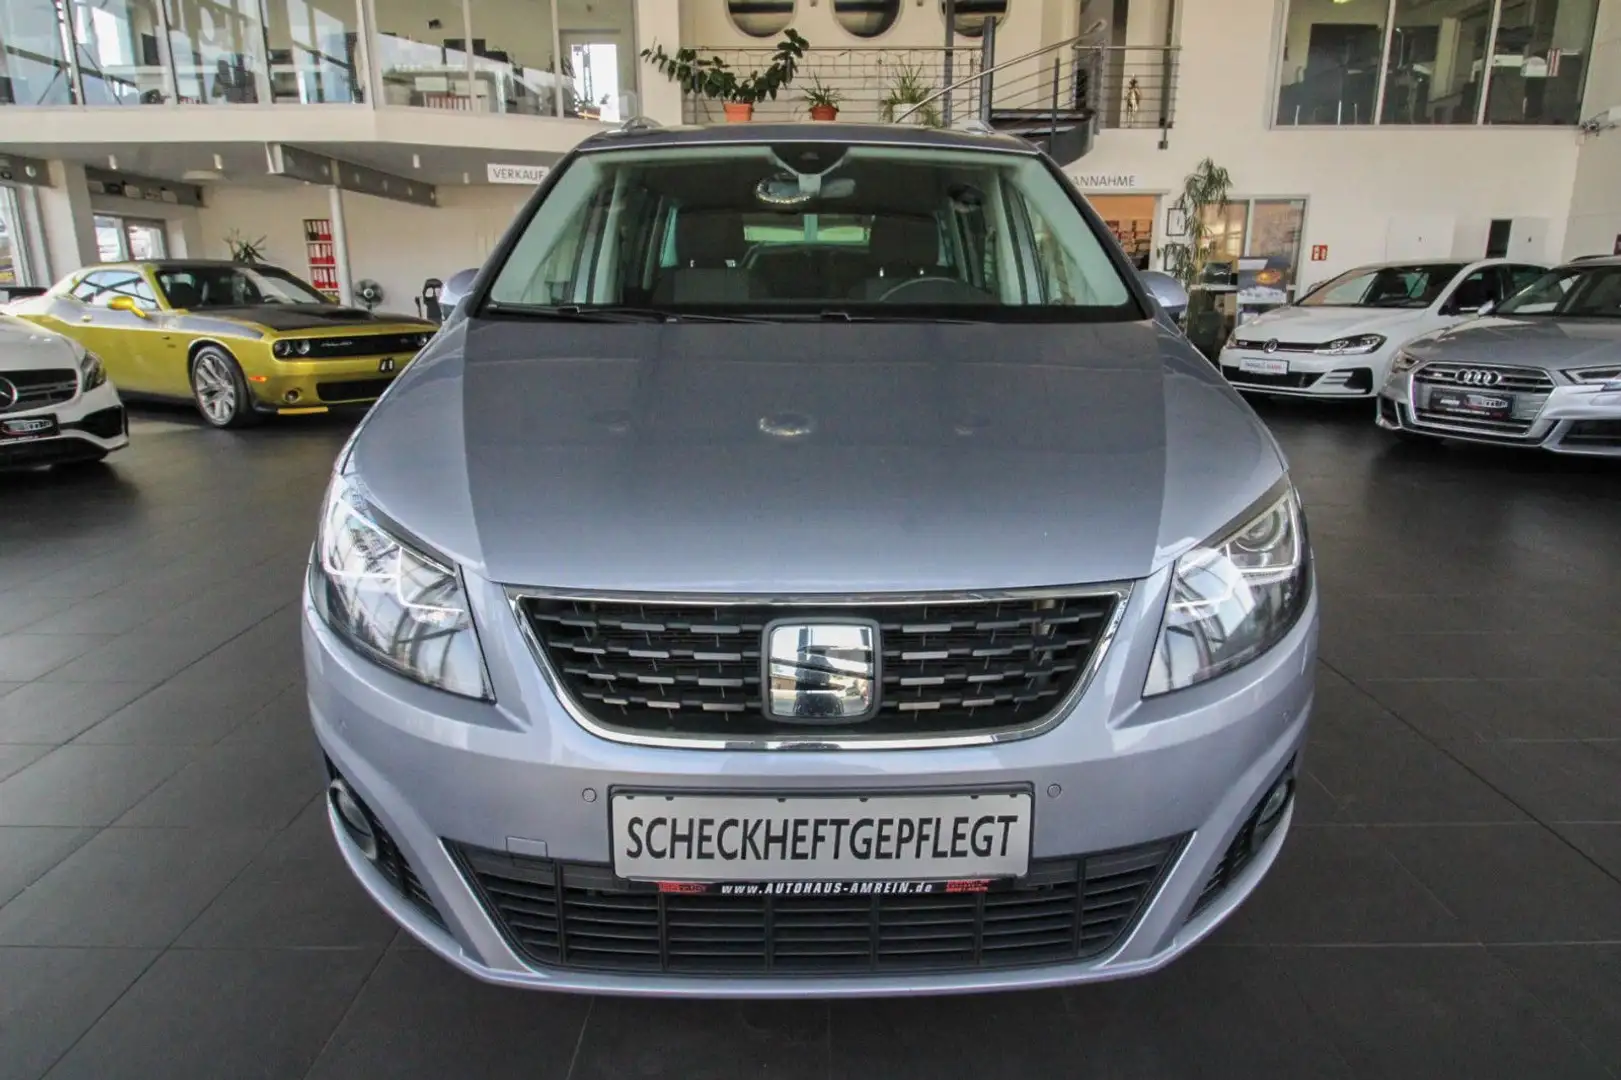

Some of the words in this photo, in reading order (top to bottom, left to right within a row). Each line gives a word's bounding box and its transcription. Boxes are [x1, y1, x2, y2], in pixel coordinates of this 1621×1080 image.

[492, 167, 545, 181] VERKAUF
[625, 814, 1019, 861] SCHECKHEFTGEPFLEGT
[721, 881, 933, 894] www.AUTOHAUS-AMREIN.de
